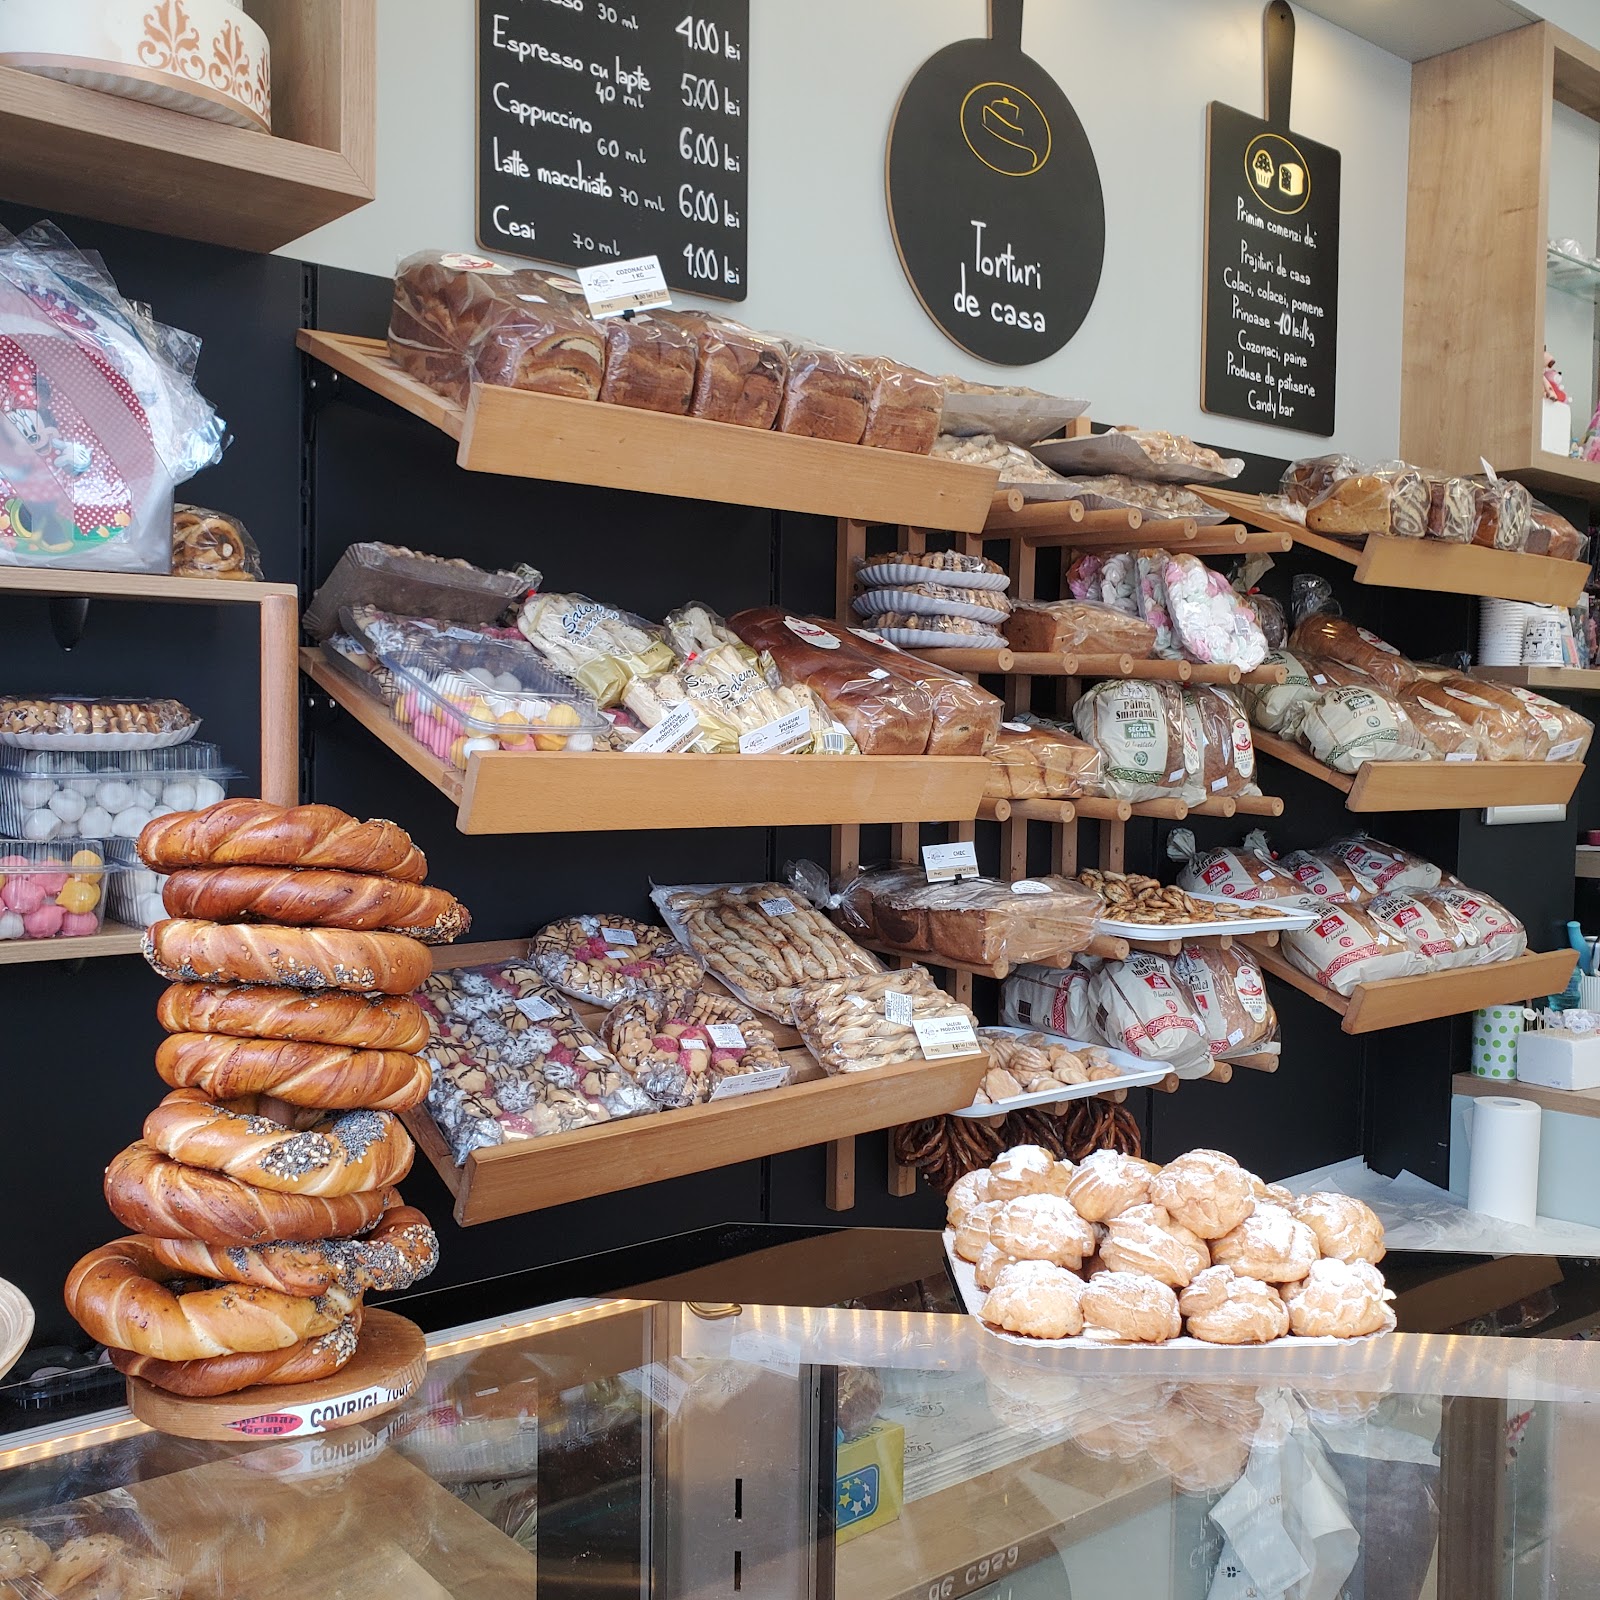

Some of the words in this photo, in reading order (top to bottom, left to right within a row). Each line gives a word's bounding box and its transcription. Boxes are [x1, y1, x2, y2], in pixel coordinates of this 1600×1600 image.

[597, 3, 617, 23] 30
[622, 15, 638, 29] ml
[493, 14, 584, 71] Espresso
[590, 63, 608, 79] cu
[615, 56, 651, 94] lapte
[724, 30, 740, 60] lei
[493, 82, 593, 134] Cappuccino
[595, 82, 616, 104] 40
[623, 94, 644, 108] ml
[681, 73, 719, 110] 5,00
[724, 87, 740, 116] lei
[597, 138, 619, 158] 60
[625, 149, 647, 164] ml
[679, 127, 719, 168] 6,00
[724, 143, 740, 172] lei
[493, 136, 531, 178] Latte
[537, 160, 613, 198] macchiato
[619, 186, 639, 207] 70
[644, 196, 665, 212] ml
[493, 205, 536, 240] Ceai
[678, 184, 719, 224] 6,00
[724, 200, 740, 229] lei
[1237, 195, 1264, 229] Primim
[1267, 221, 1302, 242] comenzi
[573, 233, 594, 250] 70
[599, 240, 621, 256] ml
[970, 220, 1041, 290] Torturi
[1241, 239, 1274, 273] Prajituri
[1276, 253, 1287, 277] de
[1290, 270, 1311, 285] casa
[616, 265, 644, 276] COZONAC
[724, 256, 740, 285] lei
[953, 262, 981, 317] de
[990, 302, 1046, 332] casa
[1224, 267, 1254, 297] Colaci,
[1257, 280, 1289, 308] colacei,
[1292, 299, 1324, 317] pomene
[1233, 294, 1270, 328] Prinoase
[1238, 329, 1281, 362] Cozonaci,
[1284, 352, 1307, 367] paine
[1227, 350, 1262, 382] Produse
[1265, 362, 1275, 386] de
[1278, 373, 1316, 397] patiserie
[1248, 389, 1276, 419] Candy
[1279, 392, 1294, 417] bar
[778, 715, 800, 729] SALEURI
[310, 1391, 378, 1428] COVRIGI
